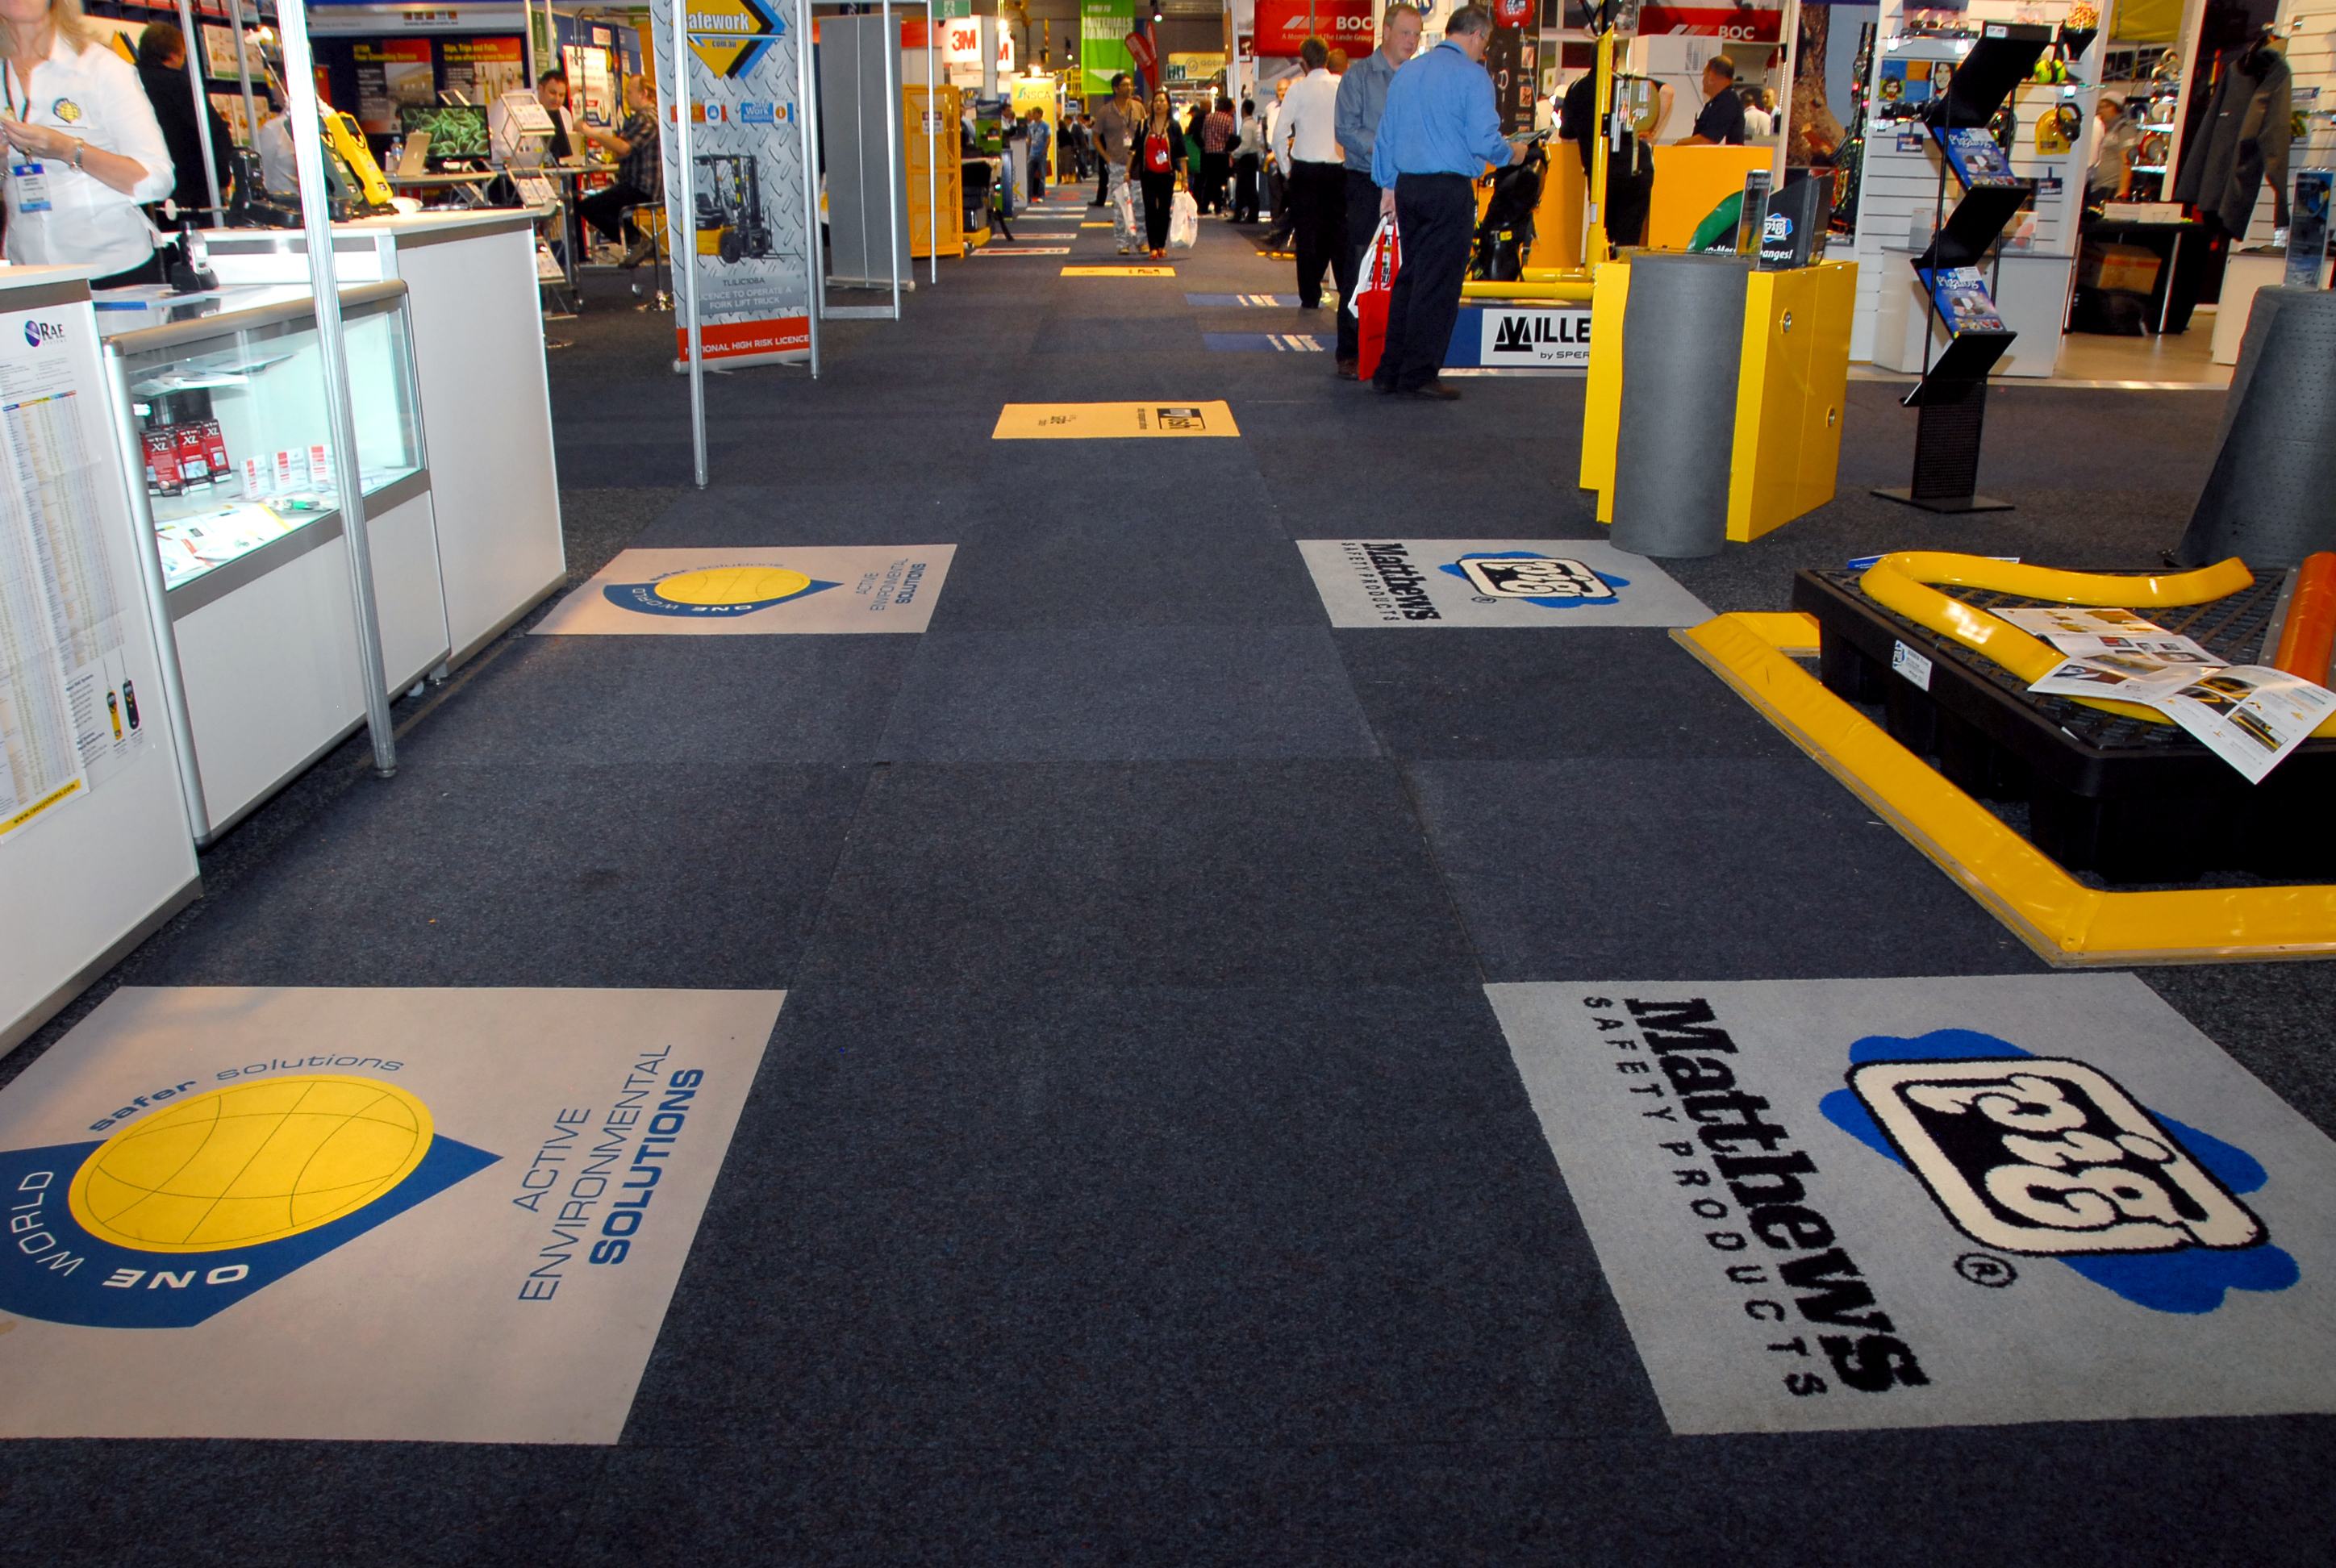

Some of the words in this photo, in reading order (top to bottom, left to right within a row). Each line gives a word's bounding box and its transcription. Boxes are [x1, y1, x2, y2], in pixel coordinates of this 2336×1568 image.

[686, 10, 749, 31] afework
[1083, 17, 1133, 27] MATERIALS
[1337, 16, 1374, 30] BOC
[952, 29, 976, 51] 3M
[1718, 25, 1755, 40] BOC
[999, 43, 1008, 60] M
[1022, 90, 1051, 100] NSCA
[745, 106, 769, 115] Work
[1760, 249, 1793, 261] anges!
[710, 301, 732, 309] FORK
[753, 297, 780, 305] TRUCK
[747, 288, 782, 297] OPERATE
[39, 323, 65, 340] RAE
[1493, 316, 1591, 352] MILLE
[685, 344, 729, 355] NIONAL
[732, 340, 753, 350] HIGH
[754, 338, 774, 348] RISK
[775, 335, 810, 344] LICENCE
[1540, 352, 1553, 360] by
[1557, 351, 1590, 359] SPER
[182, 436, 198, 446] XL
[206, 427, 219, 436] XL
[152, 442, 169, 452] XL
[856, 572, 879, 595] ACTIVE
[870, 557, 909, 611] ENVIRONMENTAL
[895, 563, 927, 604] SOLUTIONS
[1341, 542, 1362, 571] SAFETY
[1358, 569, 1401, 622] PRODUCTS
[1361, 542, 1442, 621] Matthews
[632, 587, 679, 611] WORLD
[88, 1079, 198, 1132] safer
[215, 1053, 405, 1082] solutions
[512, 1107, 592, 1213] ACTIVE
[588, 1067, 705, 1266] SOLUTIONS
[517, 1044, 673, 1302] ENVIRONMENTAL
[1583, 995, 1678, 1124] SAFETY
[1659, 1141, 1829, 1397] PRODUCTS
[1621, 996, 1932, 1393] Matthews
[9, 1170, 86, 1279] WORLD
[102, 1264, 250, 1291] ONE
